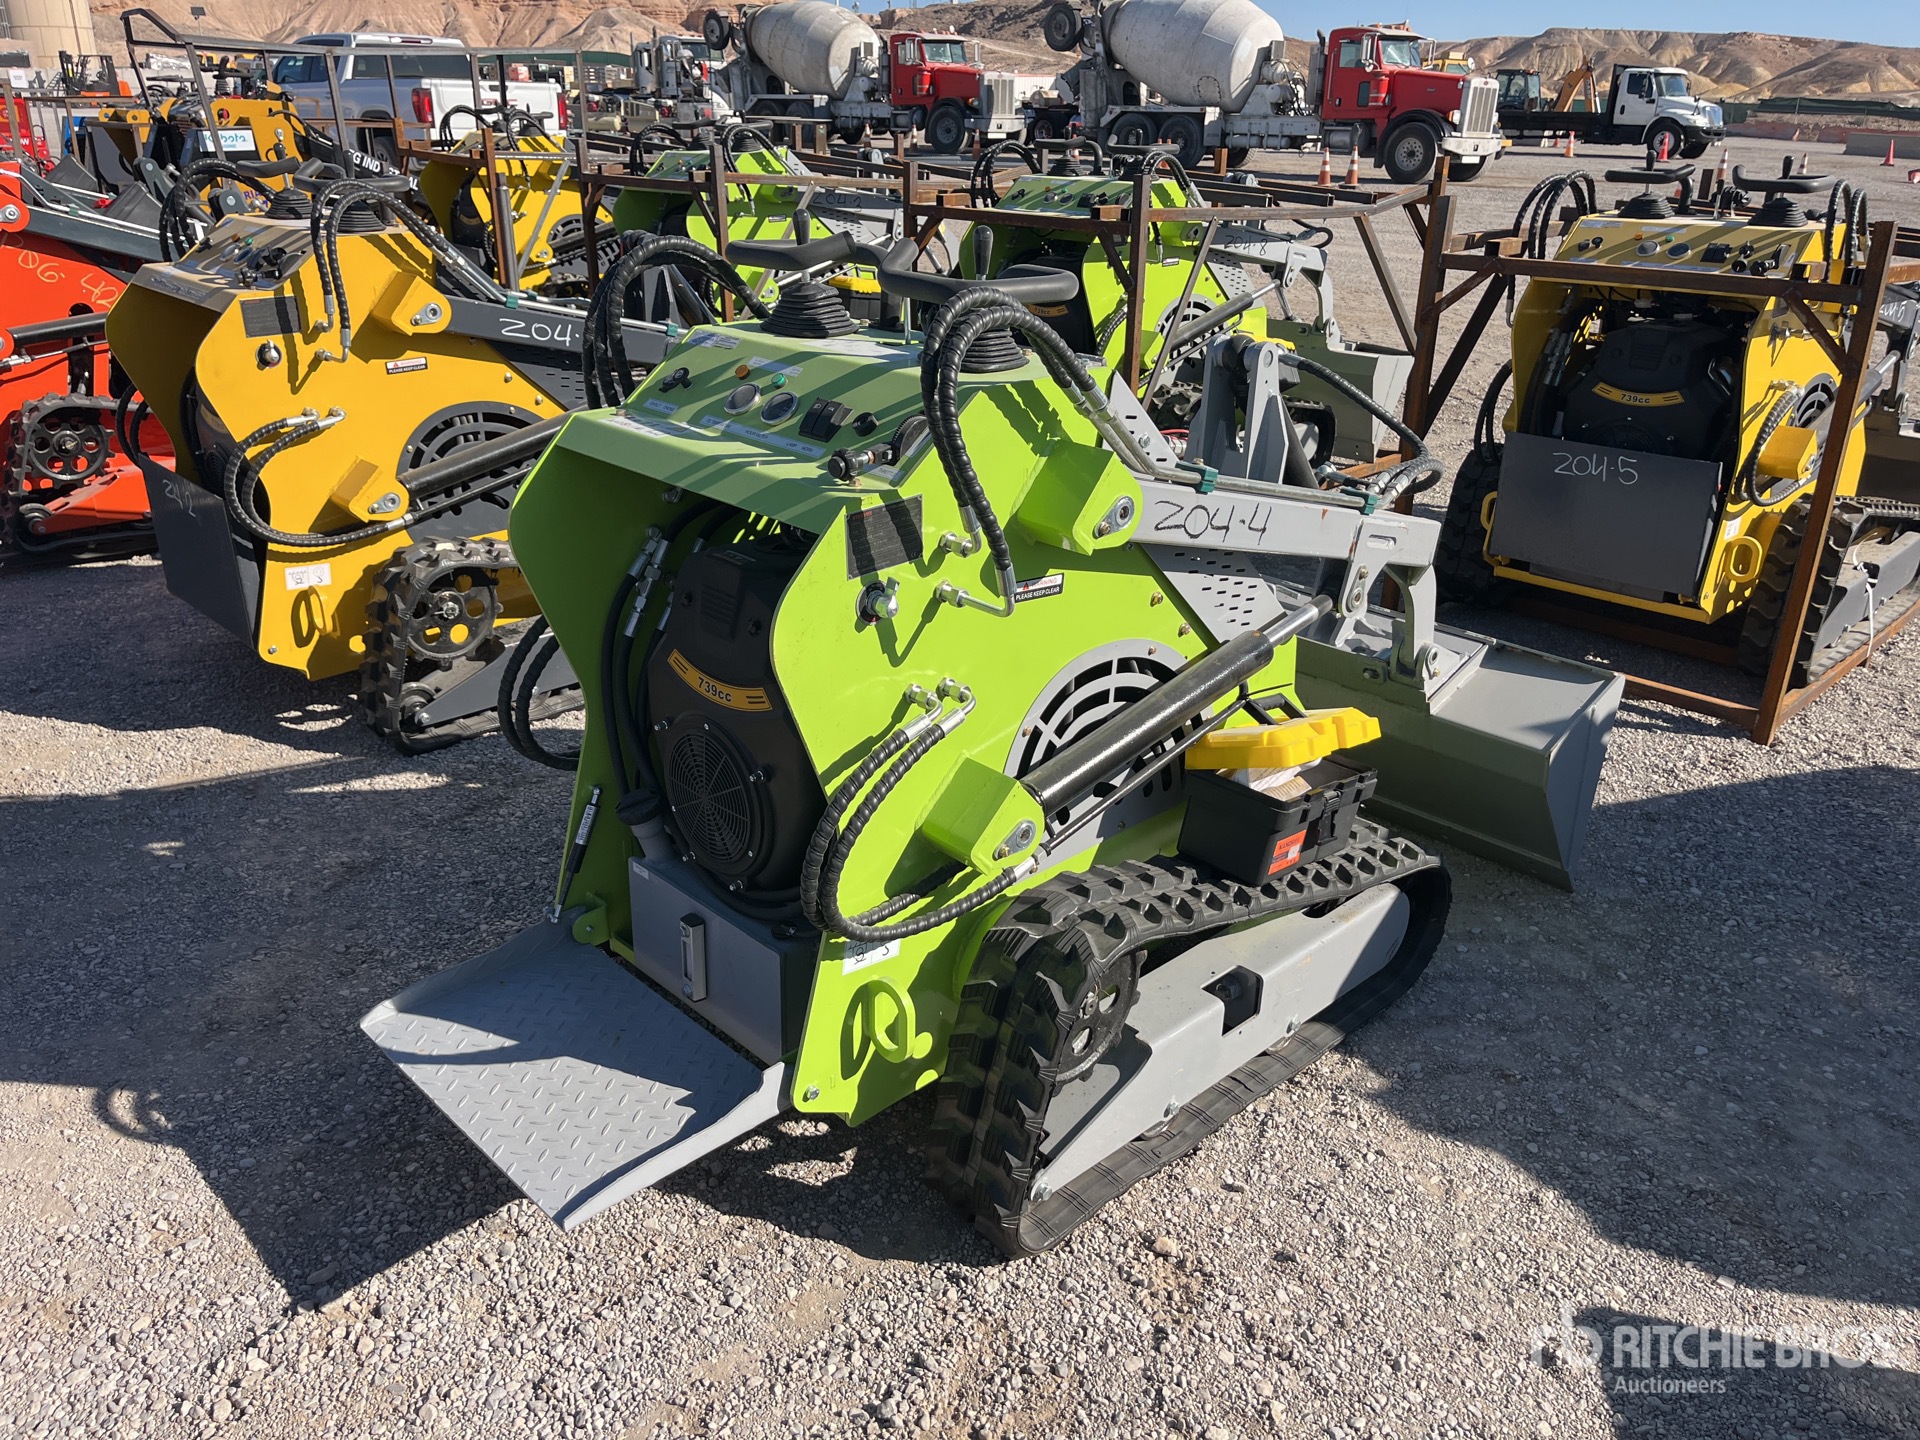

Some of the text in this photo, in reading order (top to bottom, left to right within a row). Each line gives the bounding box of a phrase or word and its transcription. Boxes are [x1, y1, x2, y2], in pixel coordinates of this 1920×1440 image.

[1621, 393, 1651, 404] 739cc
[1015, 586, 1060, 601] PLEASE KEEP CLEAR
[697, 676, 733, 703] 739cc
